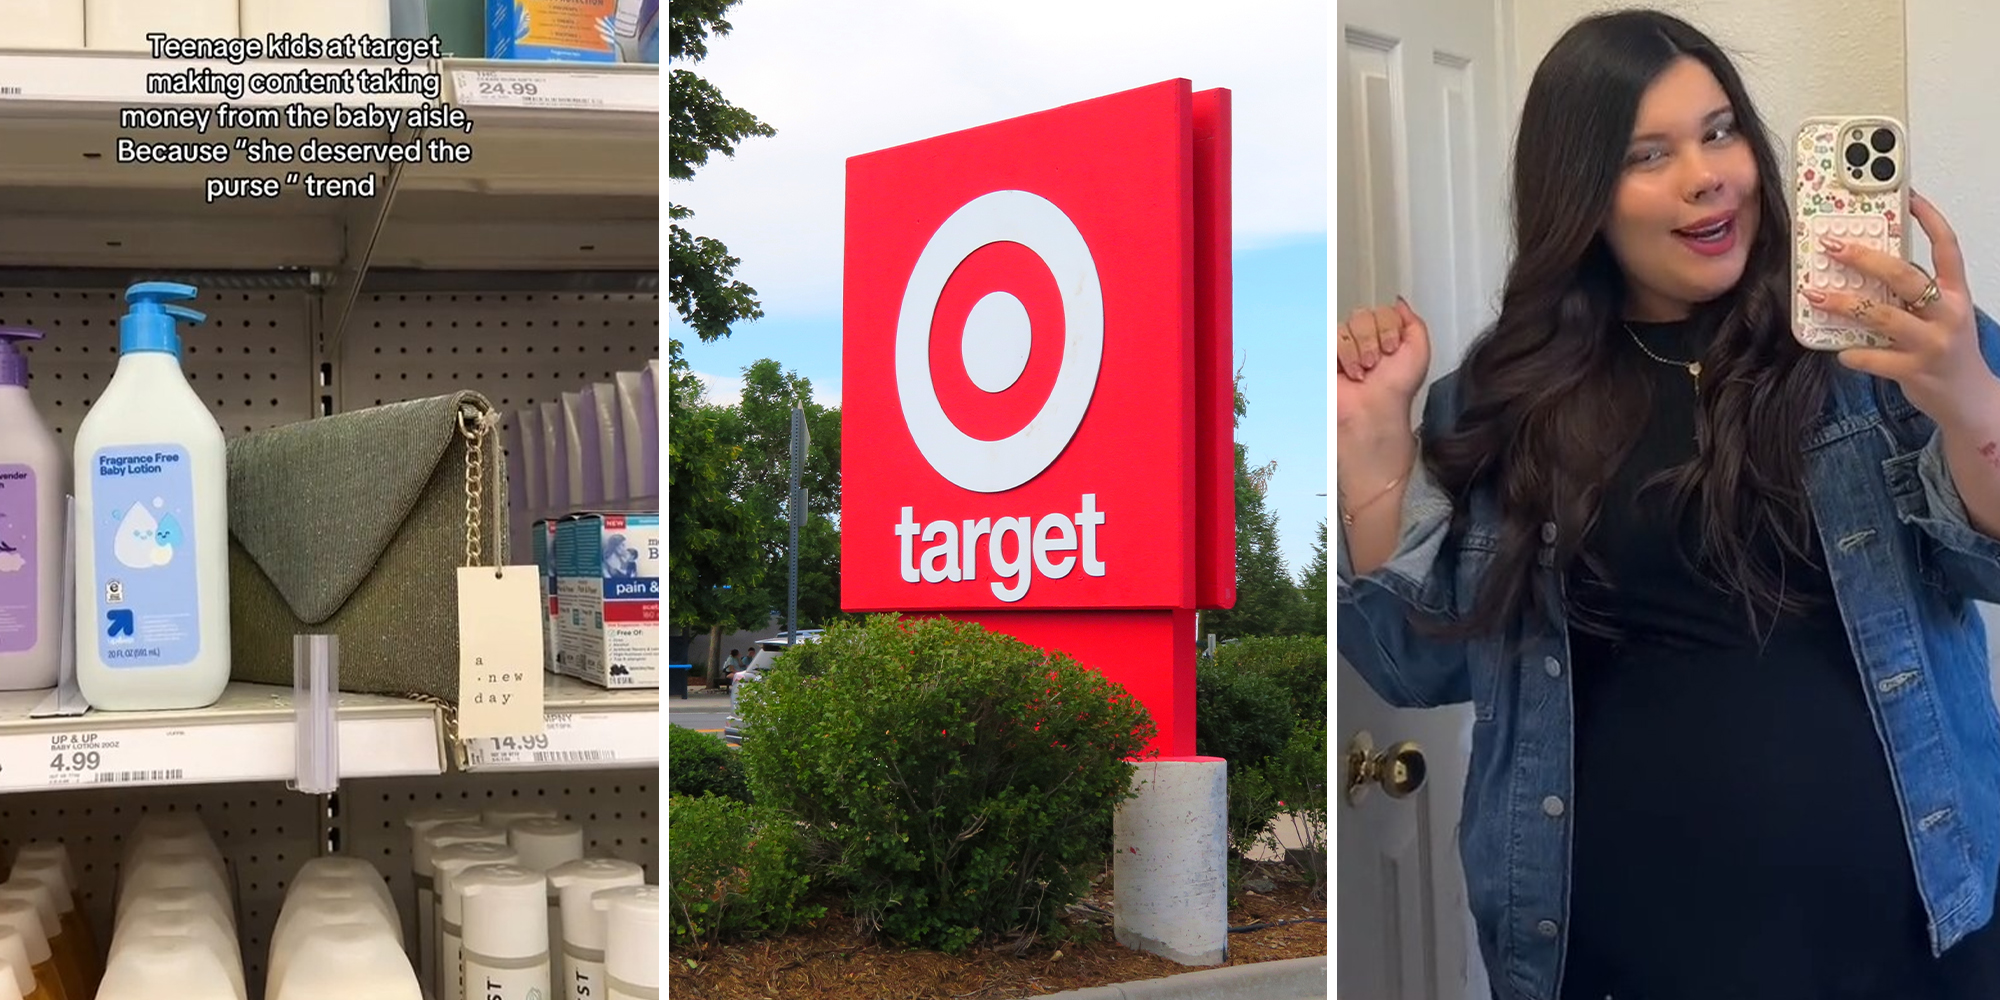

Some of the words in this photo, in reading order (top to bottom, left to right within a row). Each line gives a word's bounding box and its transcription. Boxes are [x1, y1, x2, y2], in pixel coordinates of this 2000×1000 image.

[479, 82, 538, 95] 24.99
[99, 455, 153, 466] Fragrance
[155, 452, 179, 463] Free
[100, 465, 126, 476] Baby
[128, 464, 161, 474] Lotion
[895, 493, 1106, 602] target
[616, 581, 646, 595] pain
[650, 581, 659, 593] &
[475, 656, 483, 666] a
[474, 692, 511, 705] day
[52, 735, 67, 745] UP
[71, 734, 78, 743] &
[81, 733, 98, 743] UP
[491, 734, 549, 751] 14.99
[51, 743, 71, 751] BABY
[73, 742, 100, 750] LOTION
[50, 751, 100, 771] 4.99
